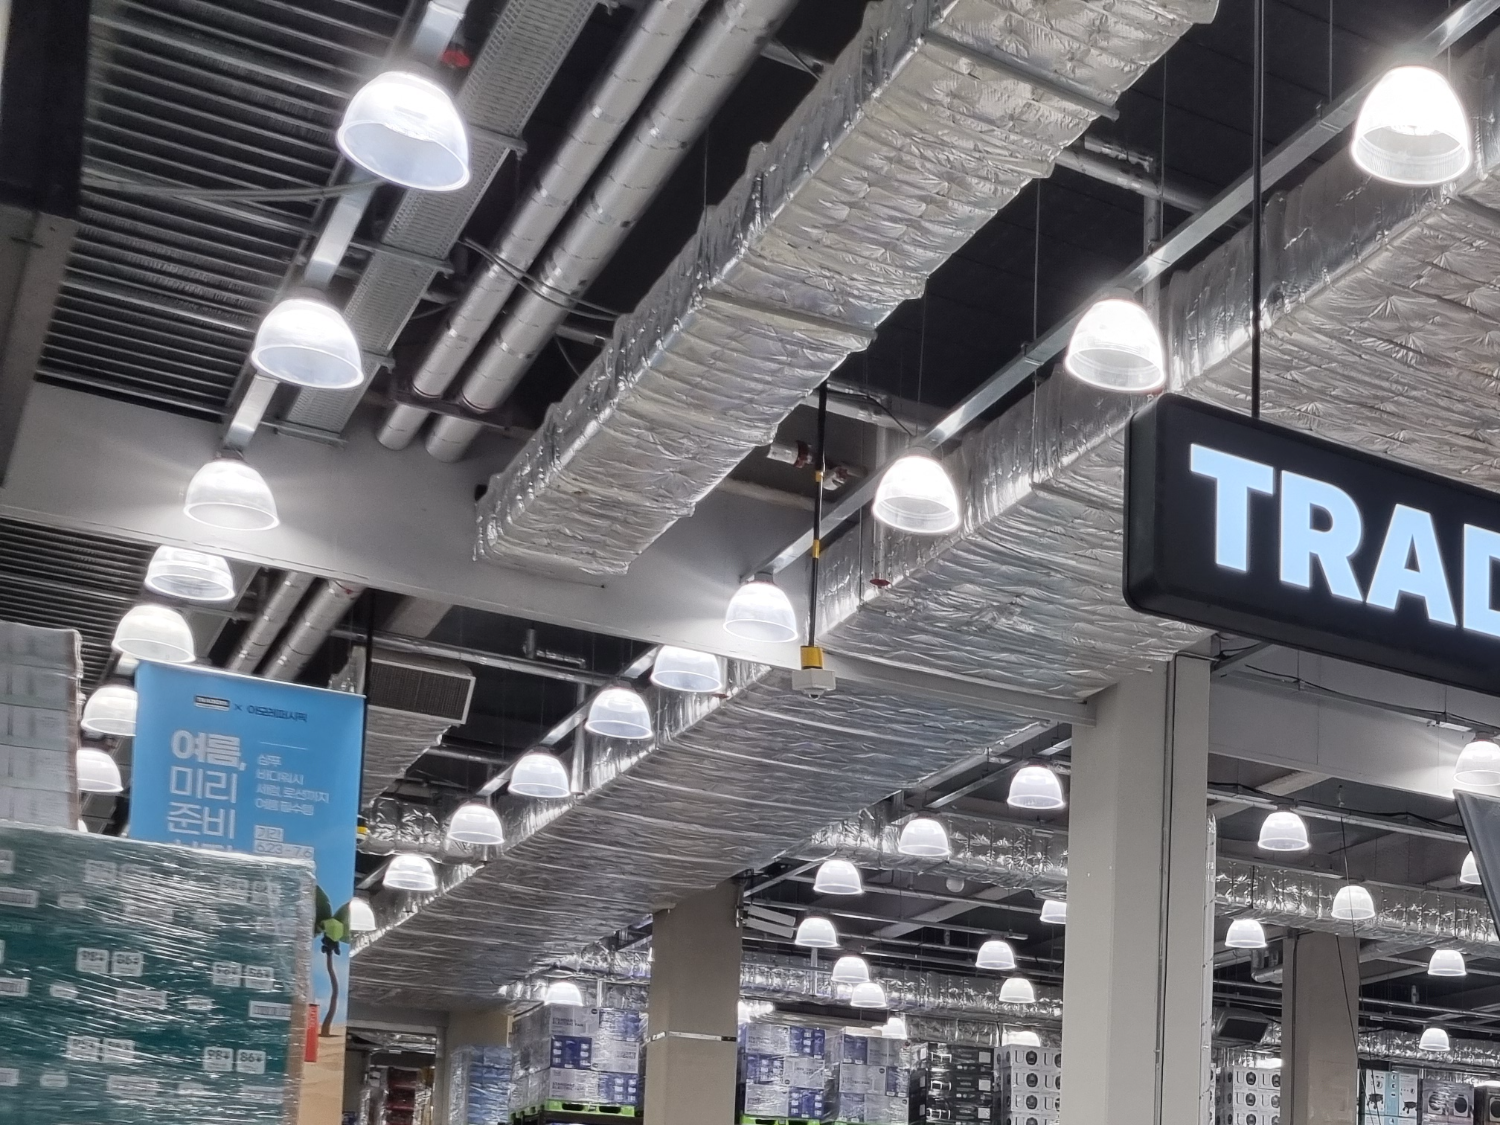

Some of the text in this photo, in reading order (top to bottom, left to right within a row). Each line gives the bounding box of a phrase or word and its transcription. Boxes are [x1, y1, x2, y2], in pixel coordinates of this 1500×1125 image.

[171, 730, 247, 771] 여름,
[169, 766, 238, 803] 미리
[167, 802, 235, 839] 준비
